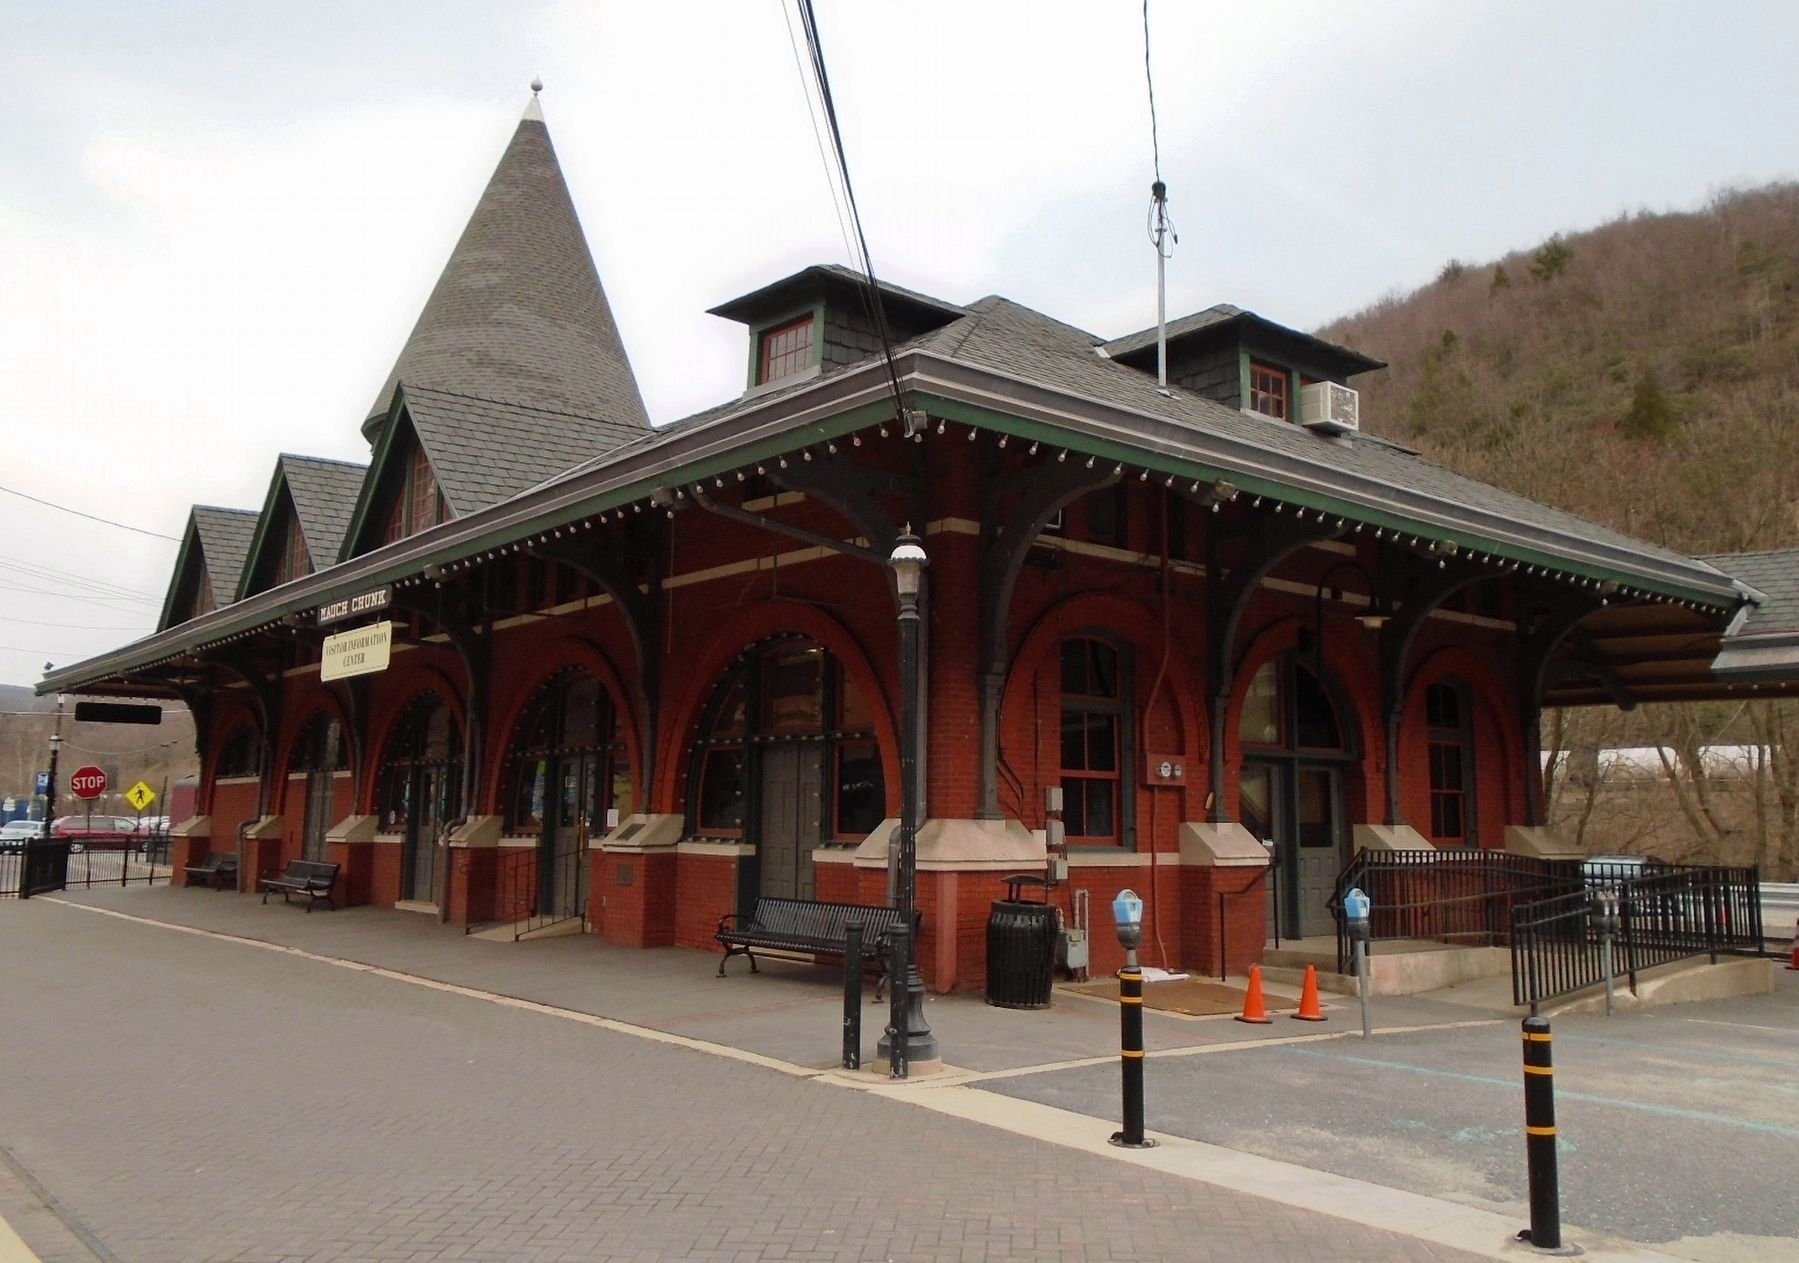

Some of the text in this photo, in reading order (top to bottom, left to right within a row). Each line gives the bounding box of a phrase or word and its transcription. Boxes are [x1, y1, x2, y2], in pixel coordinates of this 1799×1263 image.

[320, 590, 386, 621] MAUCH CHUNK
[326, 632, 387, 656] VISITOR INFORMATION
[343, 653, 365, 667] CENTER
[72, 775, 104, 790] STOP
